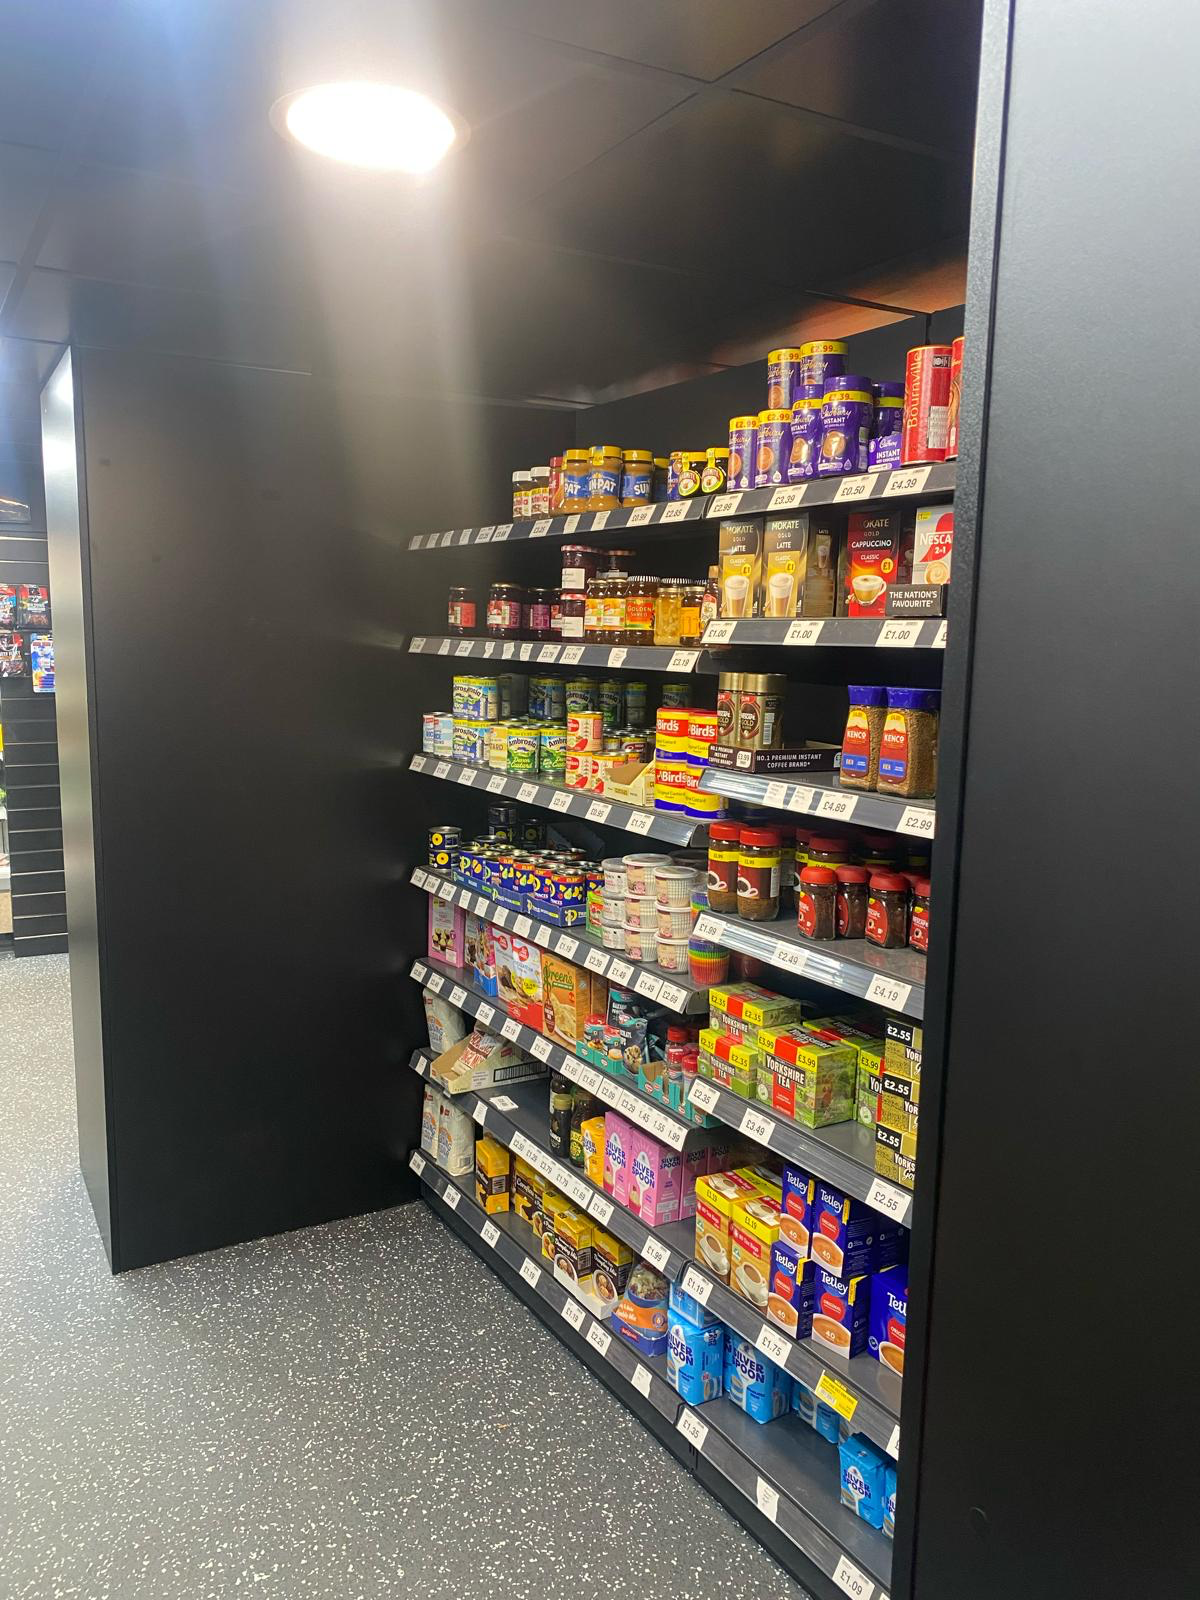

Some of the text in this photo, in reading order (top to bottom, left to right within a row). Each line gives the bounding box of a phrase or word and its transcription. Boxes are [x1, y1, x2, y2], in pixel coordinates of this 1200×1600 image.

[907, 351, 922, 428] Bournville
[876, 448, 900, 459] INSTANT
[841, 485, 866, 497] £0.50
[890, 478, 918, 490] £4.39
[774, 494, 796, 506] £3.39
[771, 520, 800, 531] MOKATE
[862, 518, 889, 529] OKATE
[776, 541, 792, 549] LATTE
[851, 539, 892, 549] CAPPUCCINO
[882, 561, 891, 570] £1
[889, 591, 938, 599] THE NATION'S
[708, 629, 727, 638] £1.00
[790, 630, 813, 640] £1.00
[884, 630, 911, 640] £1.00
[656, 719, 679, 731] Bird's
[689, 724, 716, 737] Bird's
[847, 731, 867, 739] KENCO
[884, 734, 905, 743] KENCO
[823, 801, 847, 813] £4.89
[905, 818, 933, 831] £2.99
[698, 923, 718, 936] £1.99
[777, 953, 799, 965] £2.49
[874, 986, 899, 1001] £4.19
[722, 1013, 748, 1033] YORKSHIRE
[744, 1010, 761, 1022] £2.35
[730, 1026, 739, 1036] TEA
[887, 1026, 911, 1041] £2.55
[758, 1036, 774, 1050] £3.99
[731, 1055, 748, 1067] £2.35
[797, 1054, 816, 1068] £3.99
[861, 1056, 879, 1070] £3.99
[718, 1069, 727, 1079] TEA
[766, 1054, 805, 1085] YORKSHIRE
[777, 1074, 790, 1089] TEA
[884, 1079, 910, 1095] £2.55
[693, 1088, 712, 1104] £2.35
[745, 1121, 766, 1138] £3.49
[877, 1129, 900, 1148] £2.55
[605, 1147, 626, 1168] SPOON
[606, 1140, 626, 1160] SILVER
[632, 1159, 655, 1180] SILVER
[631, 1168, 655, 1189] SPOON
[786, 1171, 808, 1195] Tetley
[820, 1189, 843, 1214] Tetley
[873, 1191, 899, 1211] £2.55
[646, 1245, 663, 1262] £1.99
[774, 1249, 798, 1275] Tetley
[687, 1277, 705, 1295] £1.19
[820, 1270, 849, 1296] Tetley
[590, 1330, 605, 1347] £2.29
[825, 1330, 836, 1340] 40
[668, 1334, 694, 1357] SILVER
[761, 1337, 782, 1357] £1.75
[668, 1342, 694, 1367] SPOON
[733, 1347, 765, 1374] SILVER
[733, 1355, 765, 1383] SPOON
[682, 1419, 700, 1439] £1.35
[843, 1469, 871, 1492] SILVER
[843, 1475, 872, 1500] SPOON
[840, 1570, 864, 1596] £1.09
